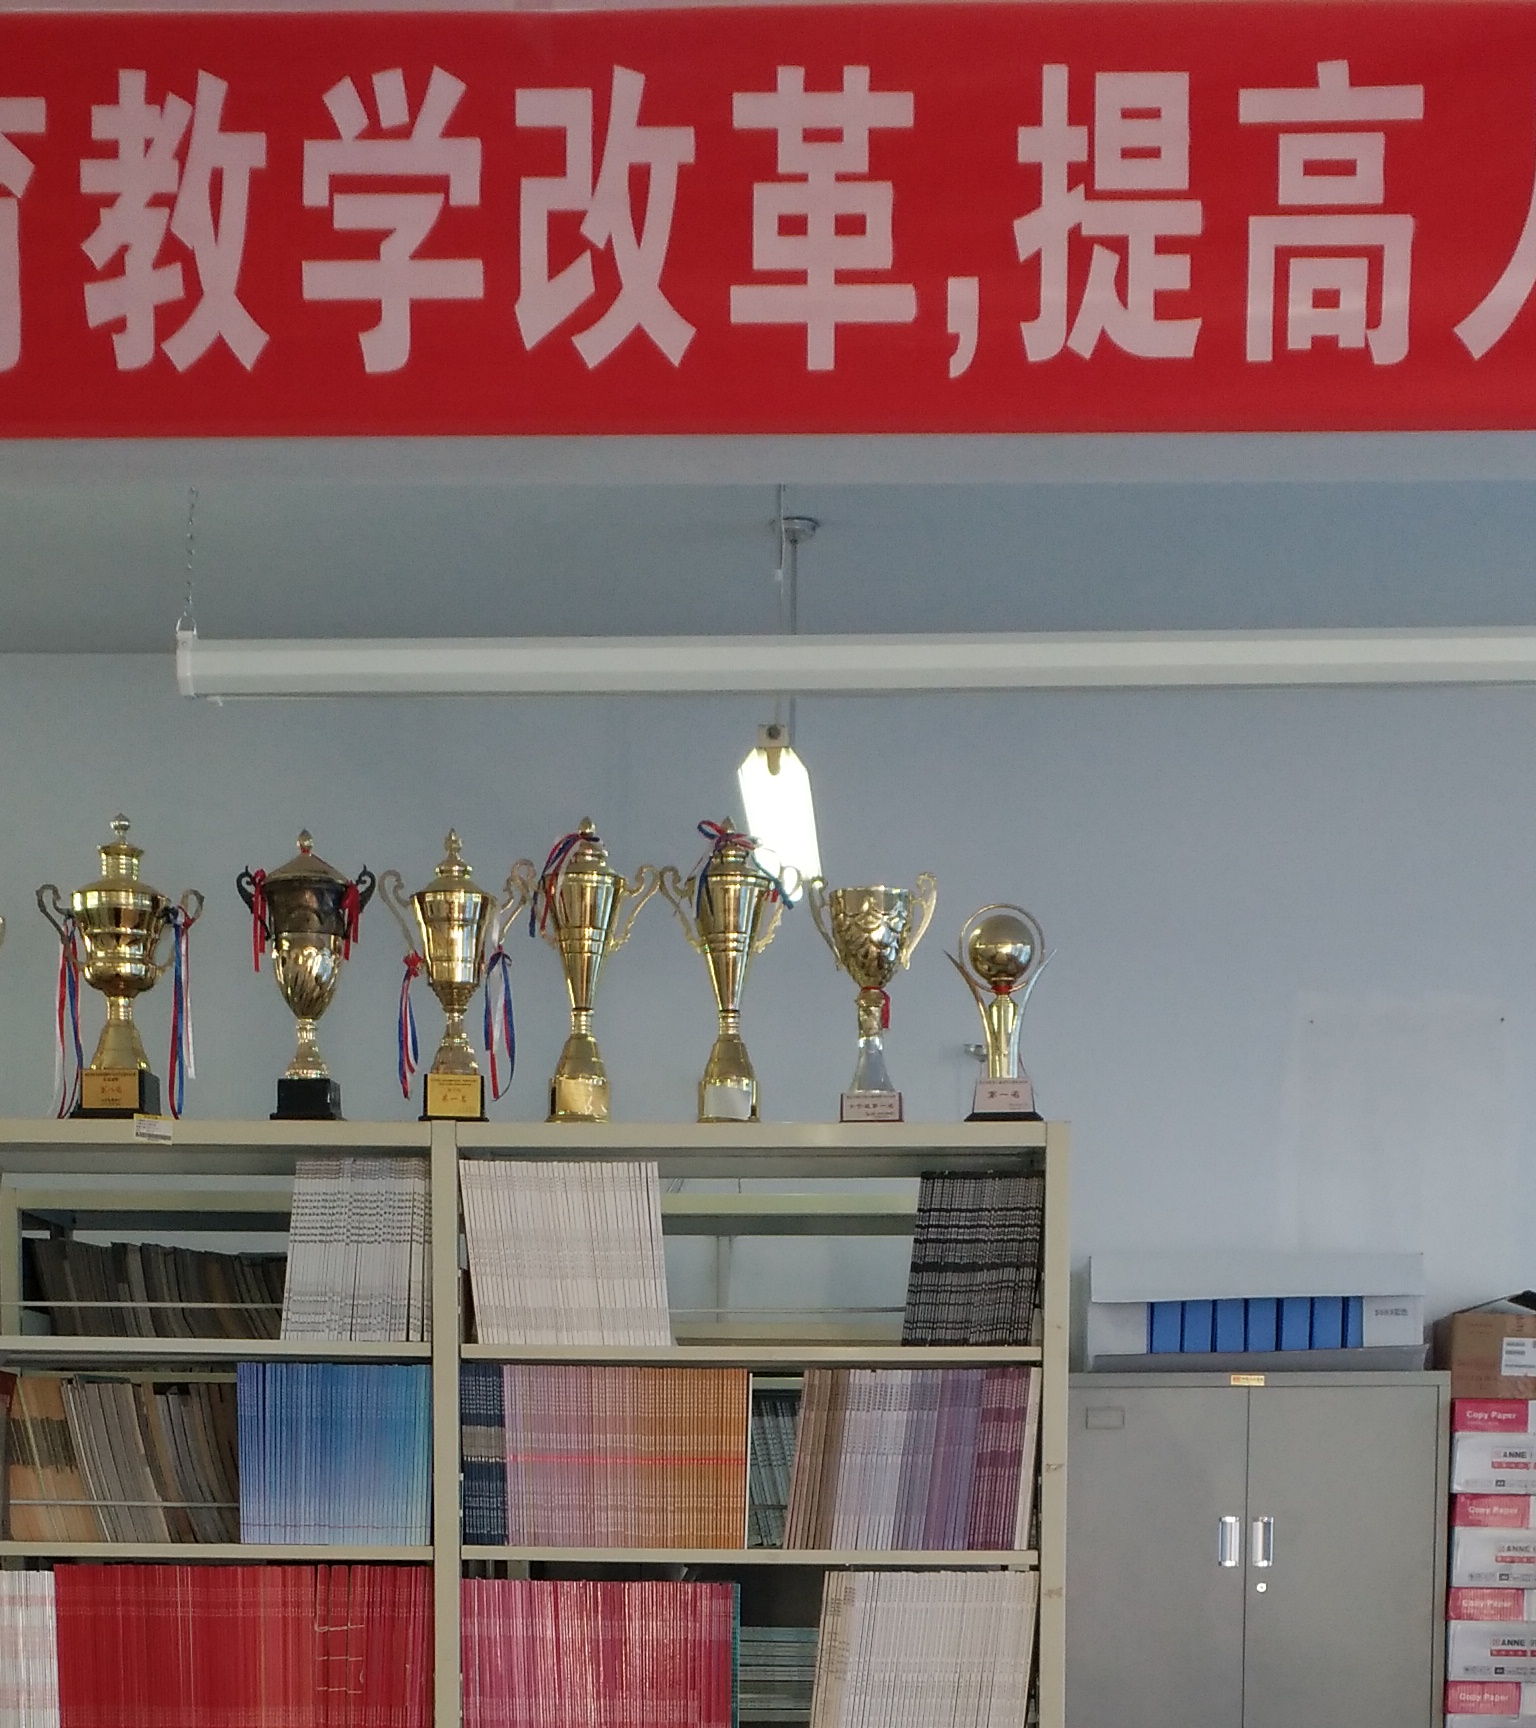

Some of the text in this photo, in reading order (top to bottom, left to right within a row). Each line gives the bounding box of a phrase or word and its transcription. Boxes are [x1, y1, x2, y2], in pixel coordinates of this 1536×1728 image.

[1466, 1410, 1516, 1420] Copy Paper
[1503, 1451, 1527, 1459] ANNE
[1468, 1506, 1518, 1516] Copy Paper
[1462, 1599, 1512, 1609] Copy Paper
[1501, 1639, 1525, 1647] ANNE
[1459, 1692, 1509, 1703] Copy Paper
